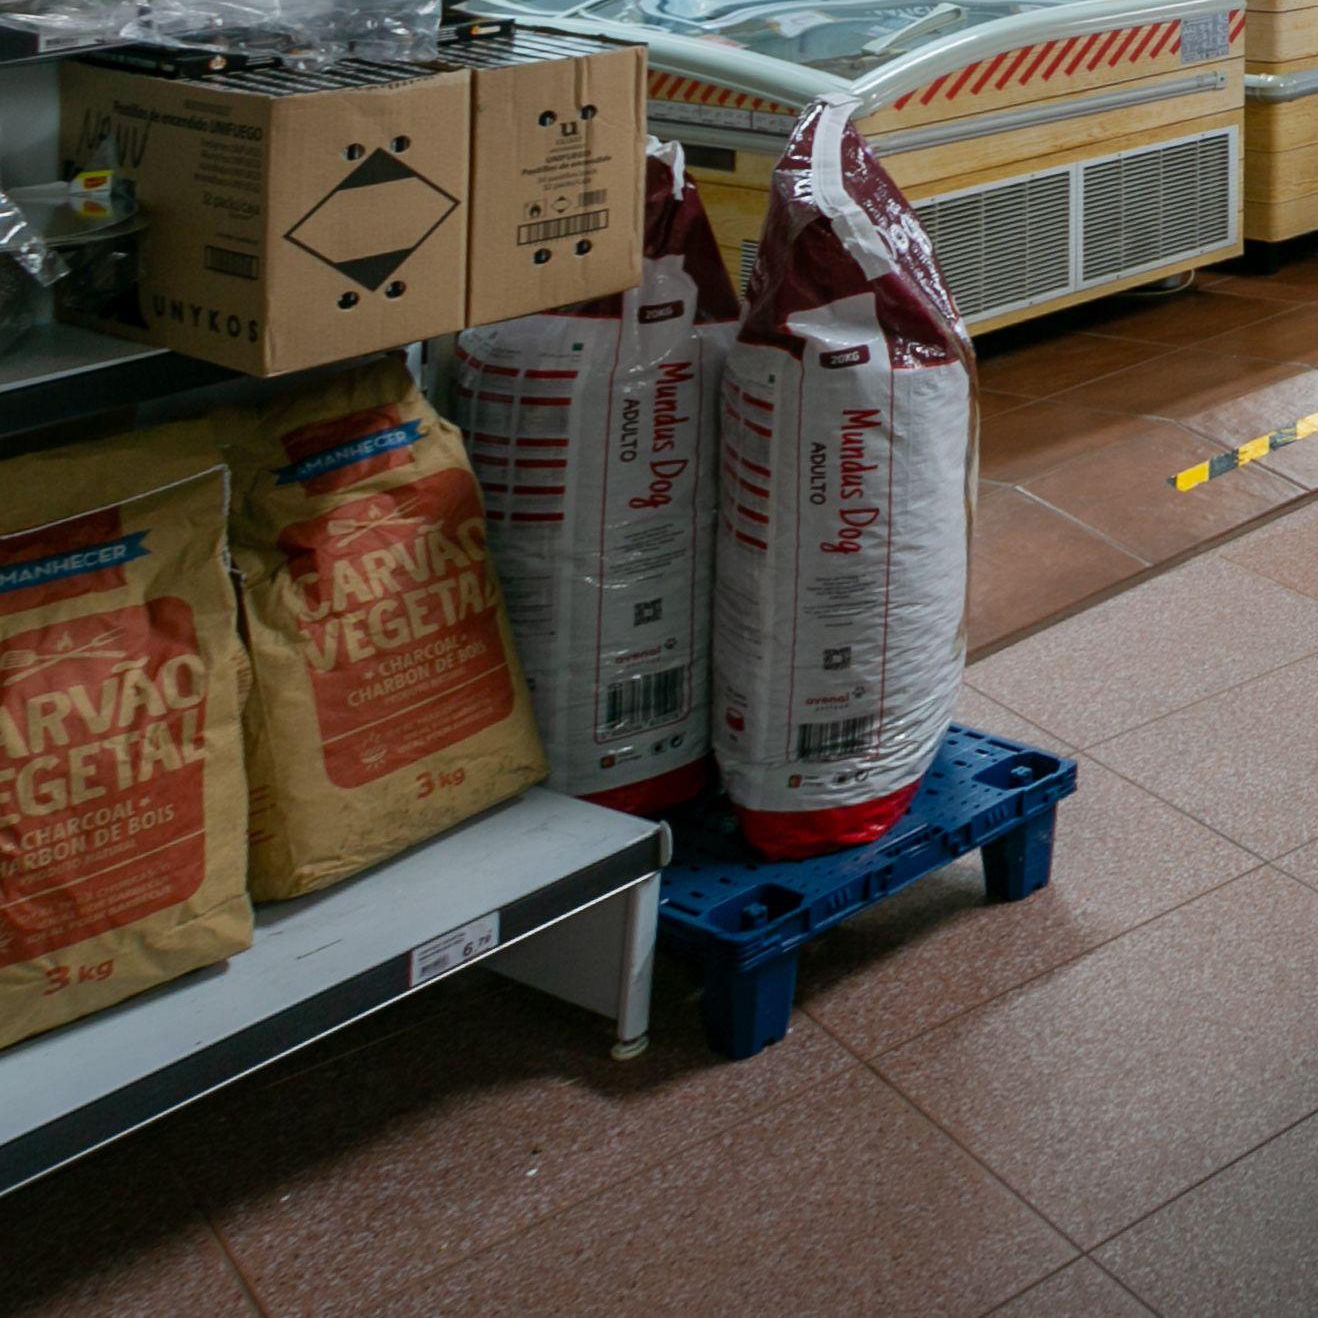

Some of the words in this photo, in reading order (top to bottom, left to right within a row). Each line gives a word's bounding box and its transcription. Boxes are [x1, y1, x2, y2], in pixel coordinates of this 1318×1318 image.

[152, 294, 258, 344] UNYKOS
[829, 349, 860, 366] 20KG
[619, 398, 640, 463] ADULTO
[652, 361, 695, 453] Mundus
[809, 442, 827, 506] ADULTO
[839, 408, 882, 501] Mundus
[628, 458, 689, 510] Dog
[820, 507, 880, 555] Dog
[0, 543, 128, 584] MANHECER
[297, 516, 489, 623] CARVÃO
[301, 569, 499, 674] VEGETAL
[347, 662, 429, 708] CHARBON
[436, 655, 455, 672] DE
[459, 642, 488, 662] BOIS
[378, 634, 460, 675] CHARCOAL
[416, 771, 436, 799] 3
[439, 765, 466, 787] kg
[19, 801, 136, 852] CHARCOAL
[95, 827, 121, 847] DE
[128, 804, 175, 836] BOIS
[45, 964, 71, 996] 3
[78, 958, 114, 983] kg
